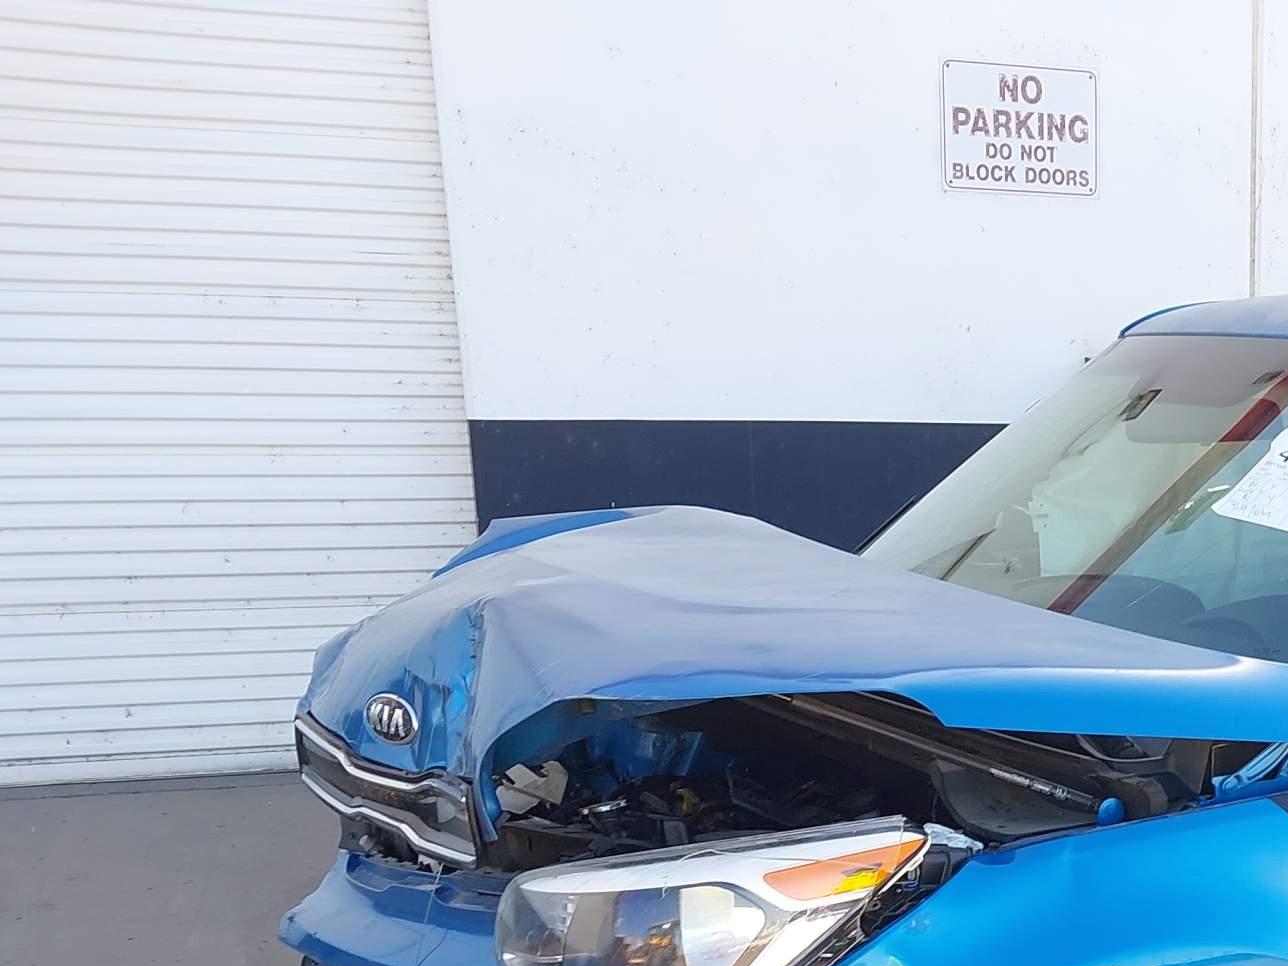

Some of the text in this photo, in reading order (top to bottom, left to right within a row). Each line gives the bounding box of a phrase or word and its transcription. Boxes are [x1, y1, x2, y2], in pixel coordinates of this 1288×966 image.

[998, 73, 1043, 105] NO
[951, 106, 1089, 144] PARKING
[985, 142, 1057, 163] DO NOT
[952, 162, 1090, 188] BLOCK DOORS
[368, 703, 406, 738] KIA
